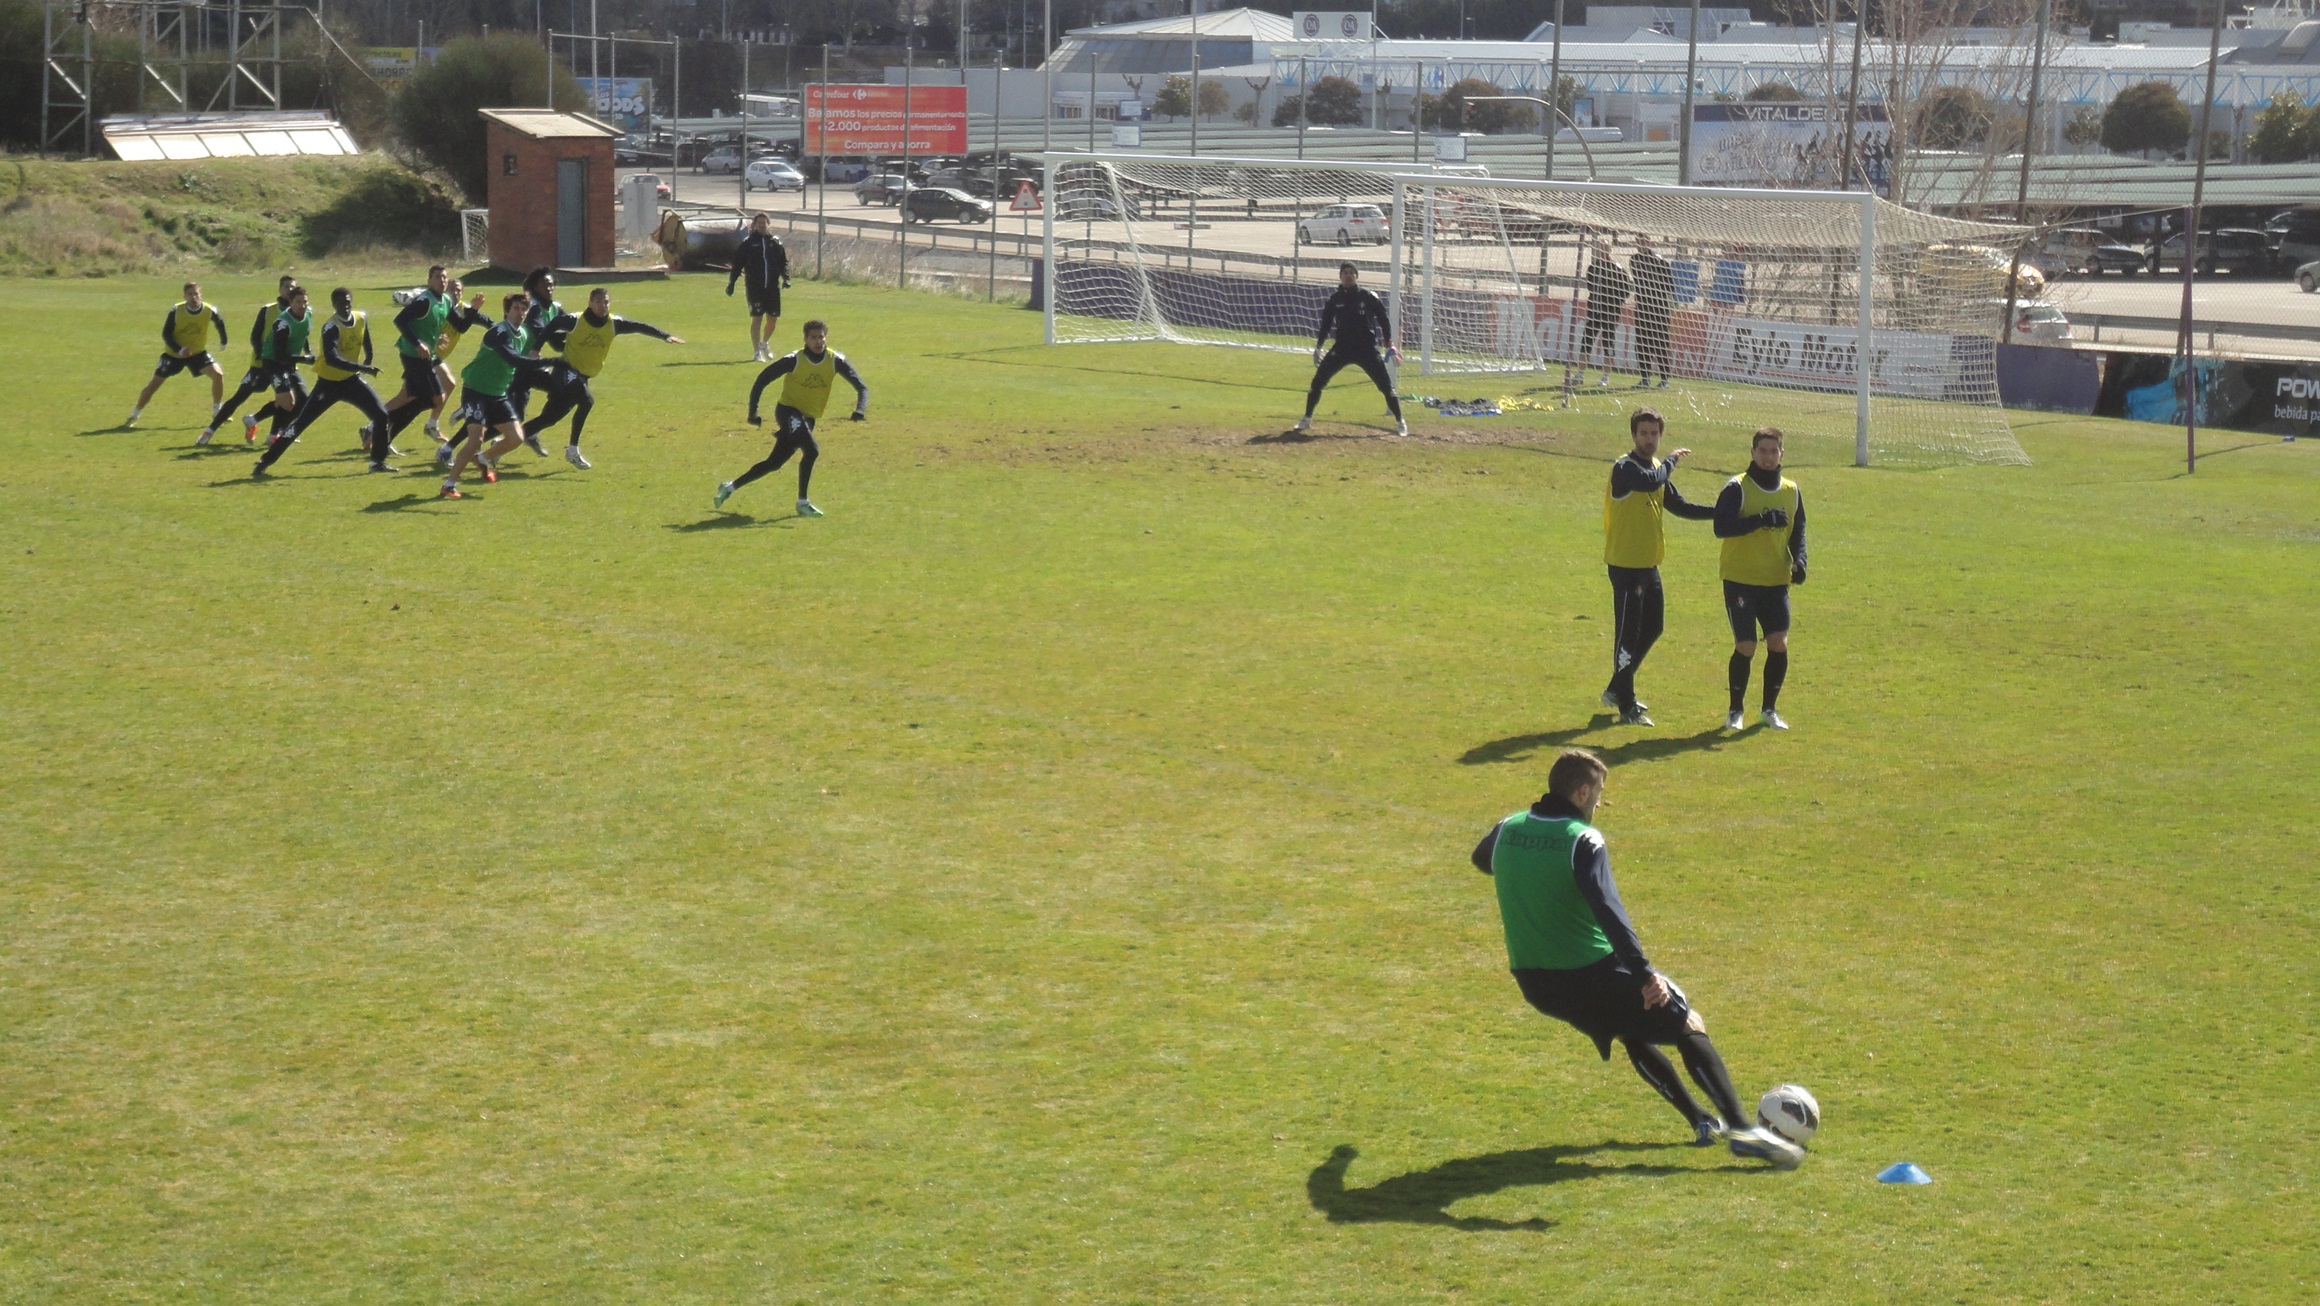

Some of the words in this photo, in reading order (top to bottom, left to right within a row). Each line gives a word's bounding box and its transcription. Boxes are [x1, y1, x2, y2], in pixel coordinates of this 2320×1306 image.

[813, 90, 850, 99] Carefour
[808, 108, 855, 118] Baamos
[857, 110, 869, 118] los
[871, 110, 902, 119] precios
[828, 121, 860, 131] 2.000
[844, 140, 889, 151] Compara
[891, 142, 897, 151] y
[898, 141, 931, 149] aorra
[2274, 404, 2308, 420] bebida
